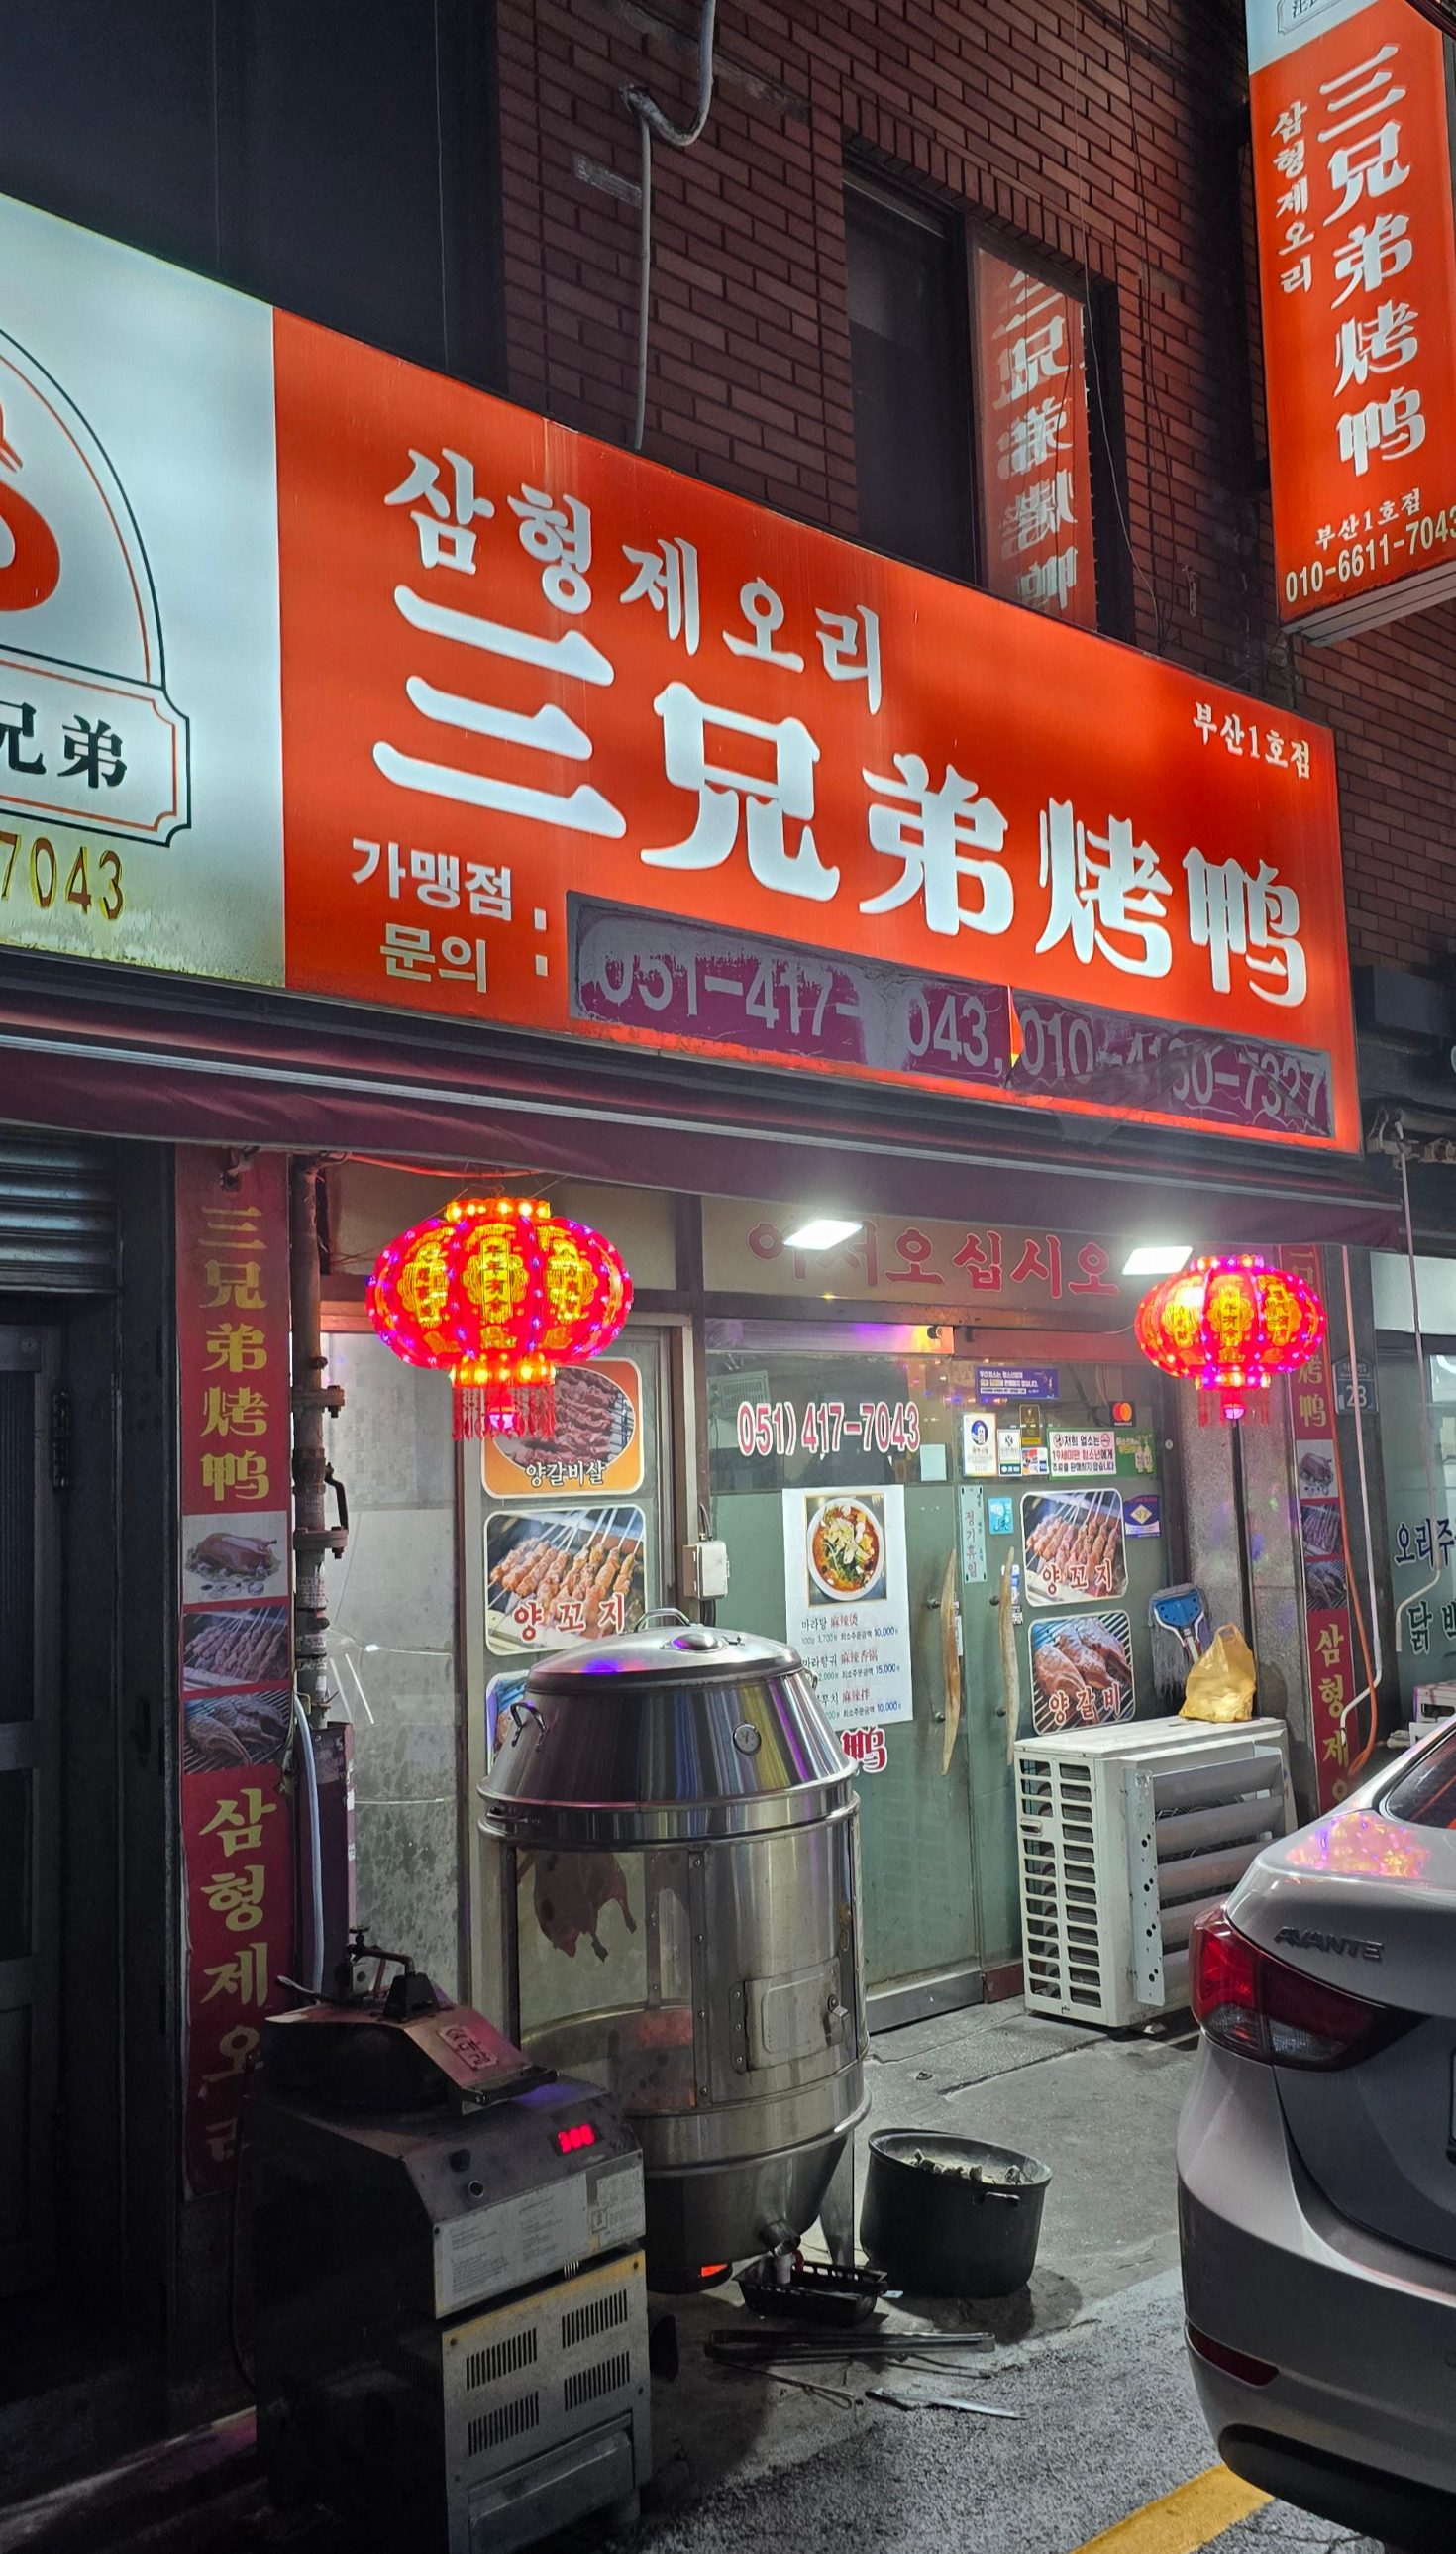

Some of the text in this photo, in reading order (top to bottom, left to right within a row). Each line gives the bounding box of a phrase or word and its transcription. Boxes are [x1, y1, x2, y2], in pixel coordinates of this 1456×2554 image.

[1271, 101, 1314, 294] 삼형제오리
[1315, 487, 1421, 551] 부산1호점
[384, 448, 882, 715] 삼형제오리
[1193, 701, 1310, 779] 부산1호점
[352, 837, 512, 922] 가맹점
[379, 922, 487, 994] 문의
[747, 1220, 1120, 1299] 어서오십시오
[525, 1459, 607, 1487] 양갈비살
[1064, 1436, 1099, 1446] 저희 업소는
[1082, 1448, 1113, 1461] 청소년에게
[965, 1511, 977, 1578] 정기휴일
[1394, 1516, 1456, 1571] 오리주
[1049, 1682, 1121, 1725] 양갈비
[1274, 1926, 1384, 1962] AVANTE
